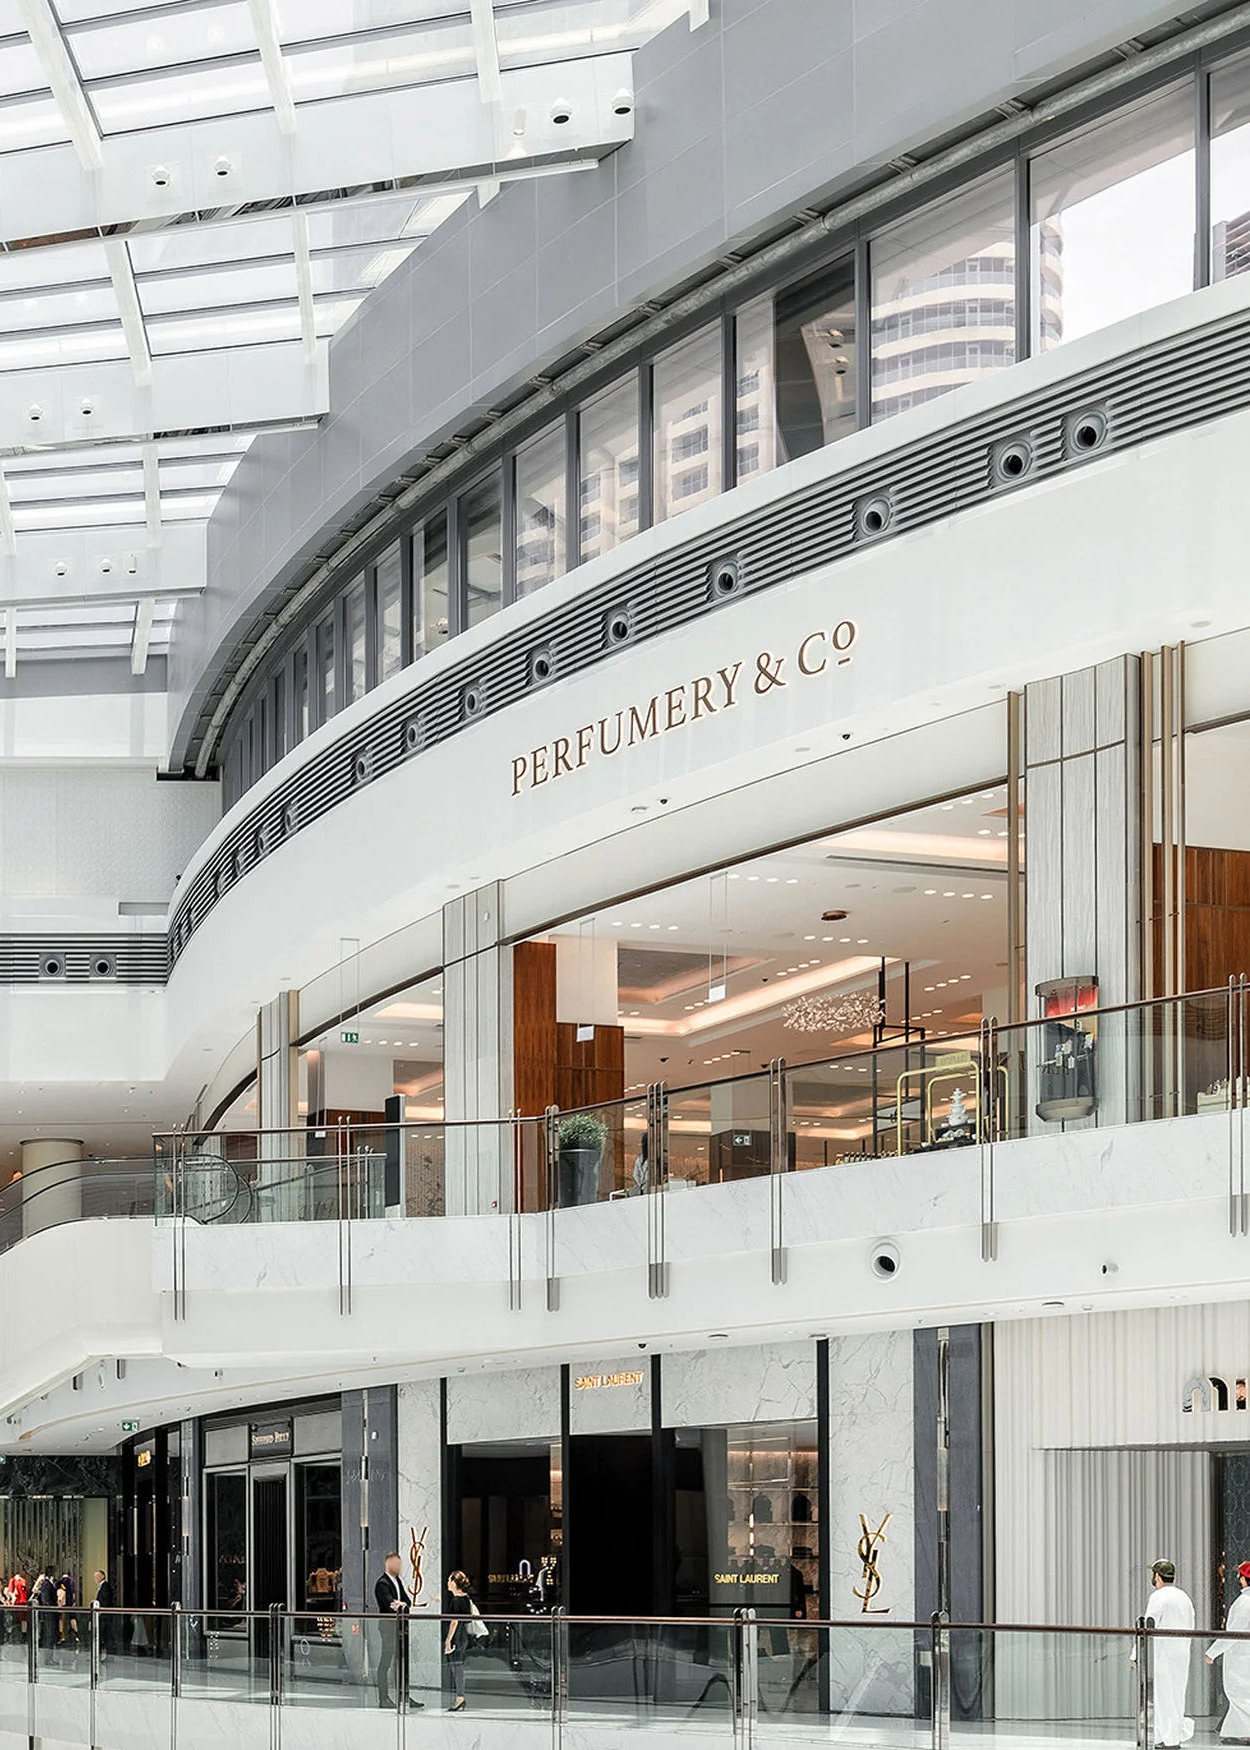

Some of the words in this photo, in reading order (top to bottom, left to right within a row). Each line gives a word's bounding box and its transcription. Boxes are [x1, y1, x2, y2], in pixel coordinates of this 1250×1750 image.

[510, 661, 743, 796] PERFUMERY
[754, 651, 786, 696] &
[574, 1376, 599, 1390] SAINT
[600, 1370, 644, 1388] LAURENT
[714, 1573, 738, 1584] SAINT
[739, 1573, 780, 1584] LAURENT
